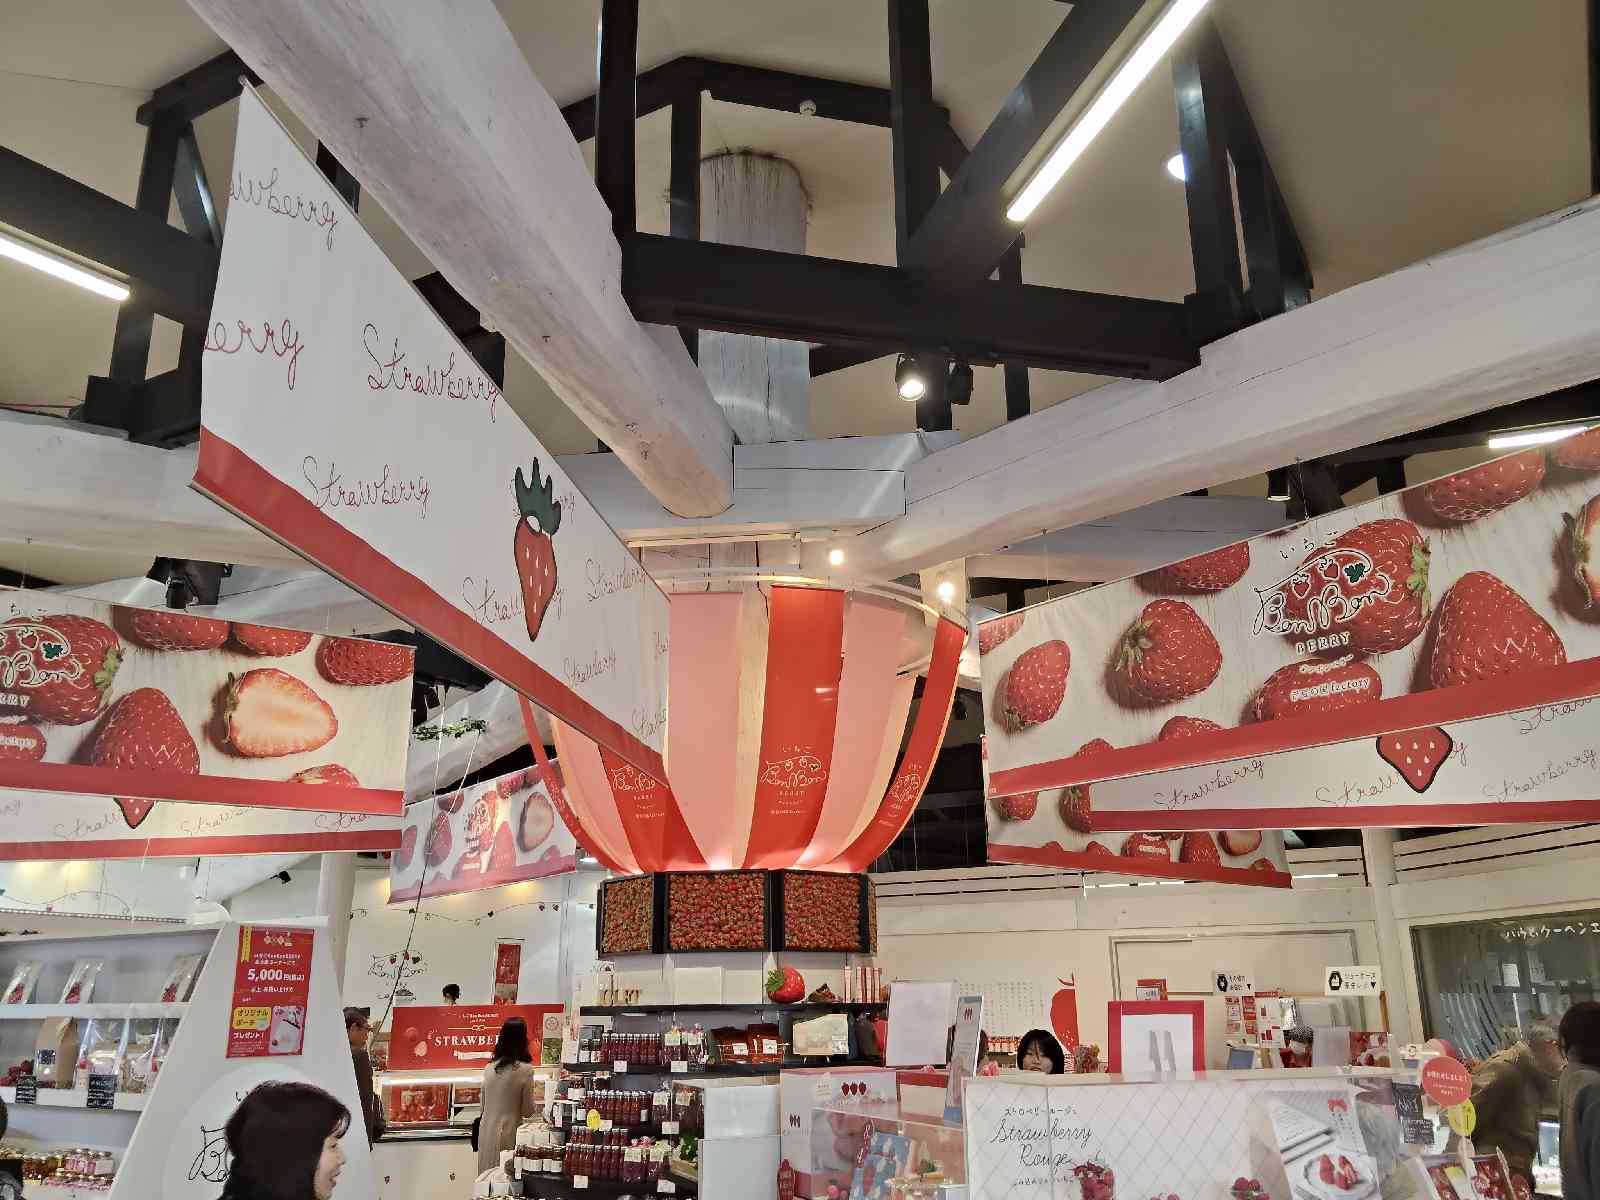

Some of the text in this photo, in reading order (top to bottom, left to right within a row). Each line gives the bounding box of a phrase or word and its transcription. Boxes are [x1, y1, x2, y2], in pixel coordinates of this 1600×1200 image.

[363, 322, 500, 424] Strawberry
[302, 455, 430, 521] Strawberry
[1280, 531, 1338, 559] いちご
[1296, 632, 1350, 654] BERRY
[1152, 757, 1265, 809] Strawberry
[988, 1118, 1092, 1149] Strawberry
[1018, 1143, 1073, 1176] Rouge
